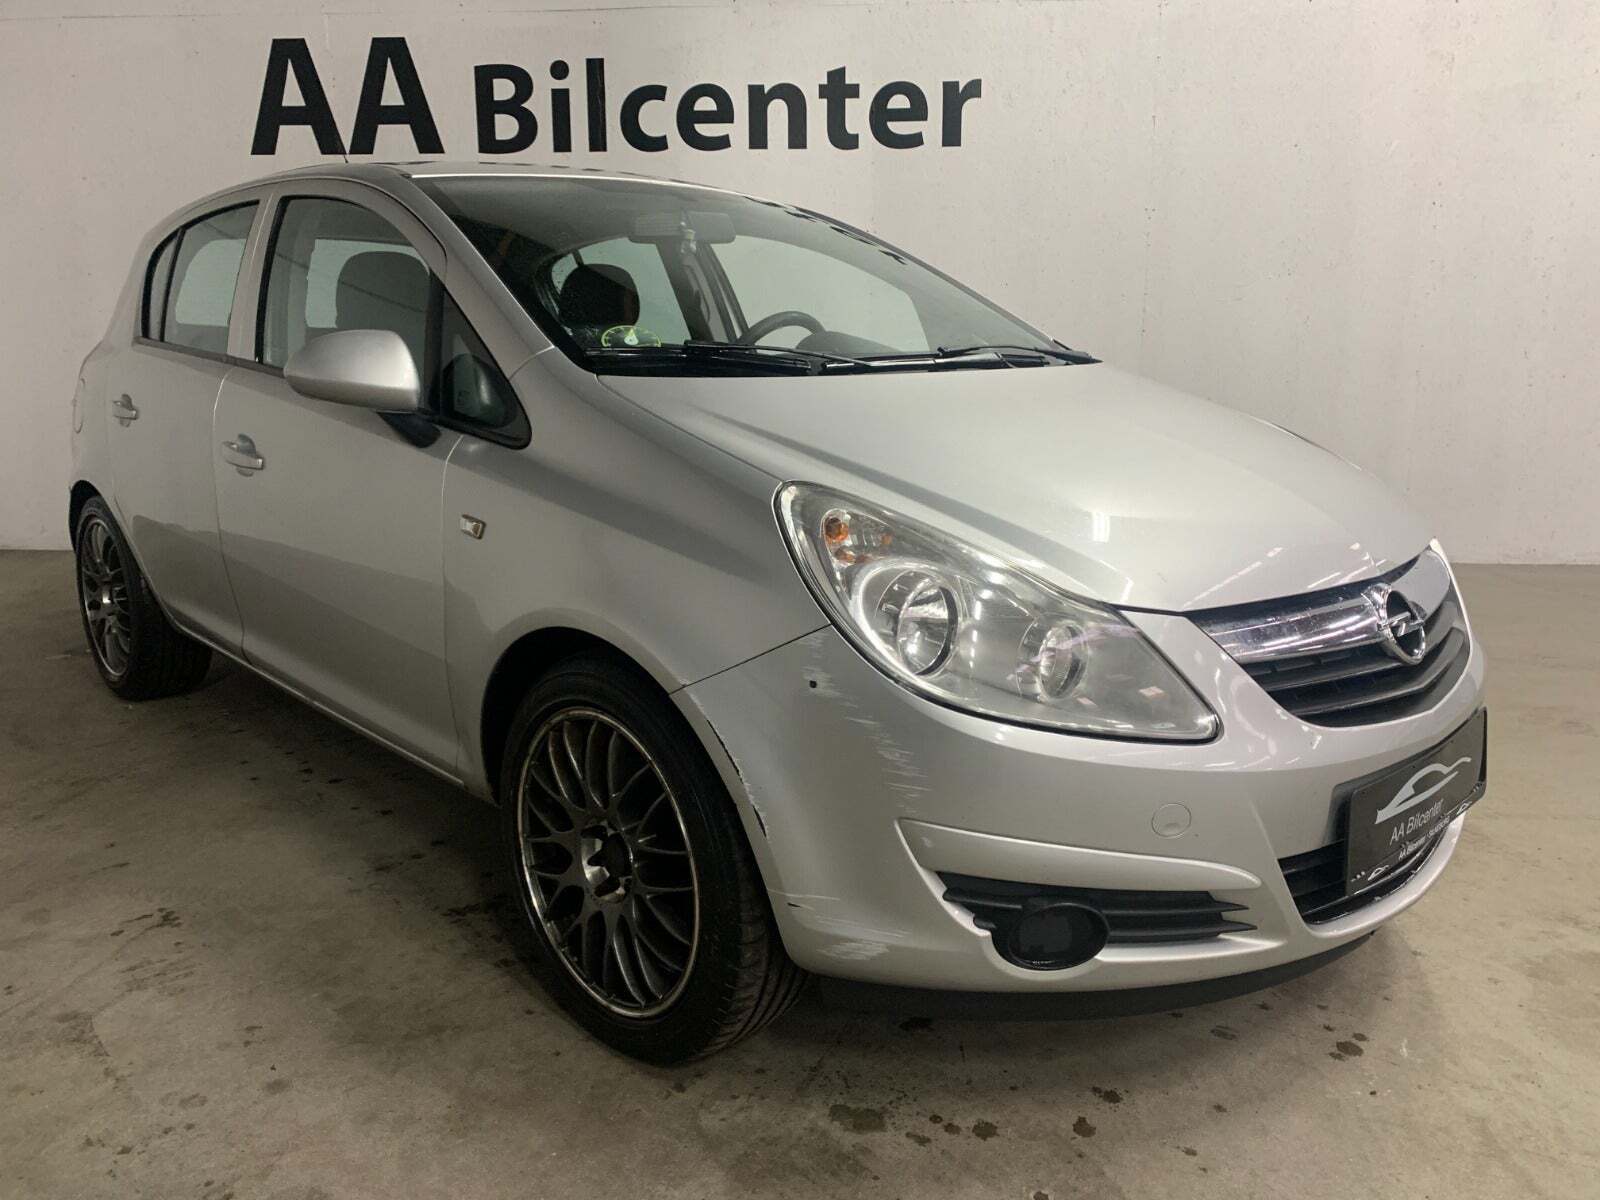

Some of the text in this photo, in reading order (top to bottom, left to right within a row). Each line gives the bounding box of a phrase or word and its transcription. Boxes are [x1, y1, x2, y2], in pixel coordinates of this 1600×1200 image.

[250, 37, 982, 156] AA Bilcenter
[1389, 822, 1405, 847] AA
